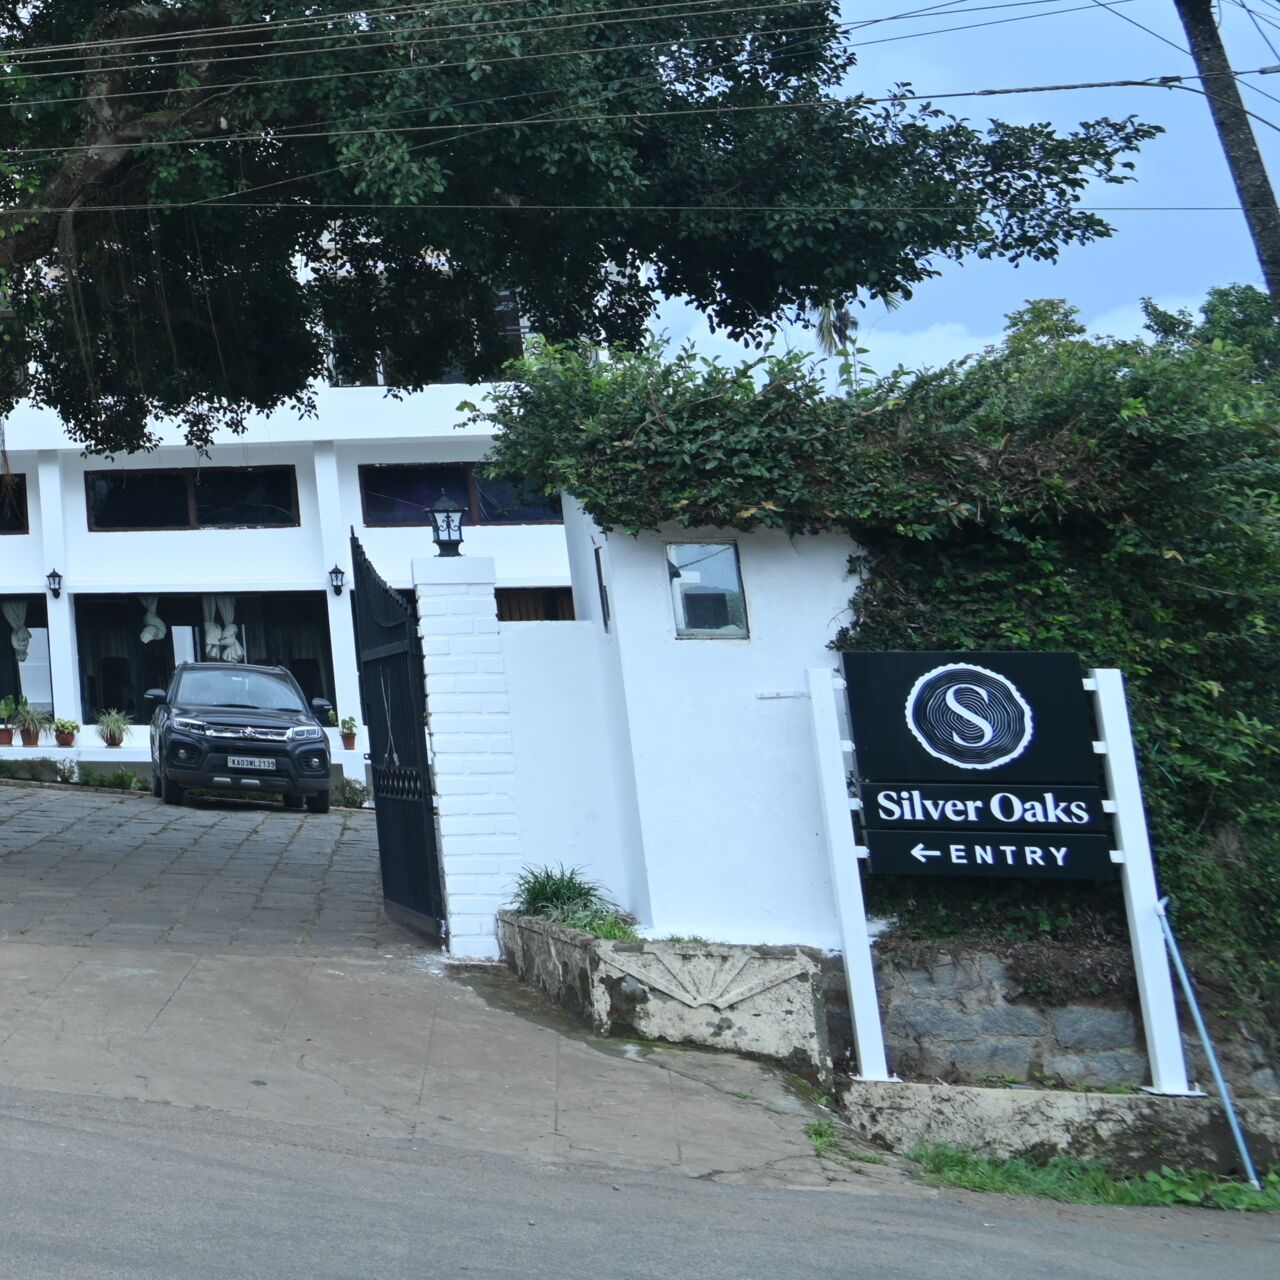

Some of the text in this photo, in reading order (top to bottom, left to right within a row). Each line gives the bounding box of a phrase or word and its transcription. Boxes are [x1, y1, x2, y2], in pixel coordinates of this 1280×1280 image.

[877, 790, 1090, 824] Silver Oaks
[949, 844, 1069, 866] ENTRY
